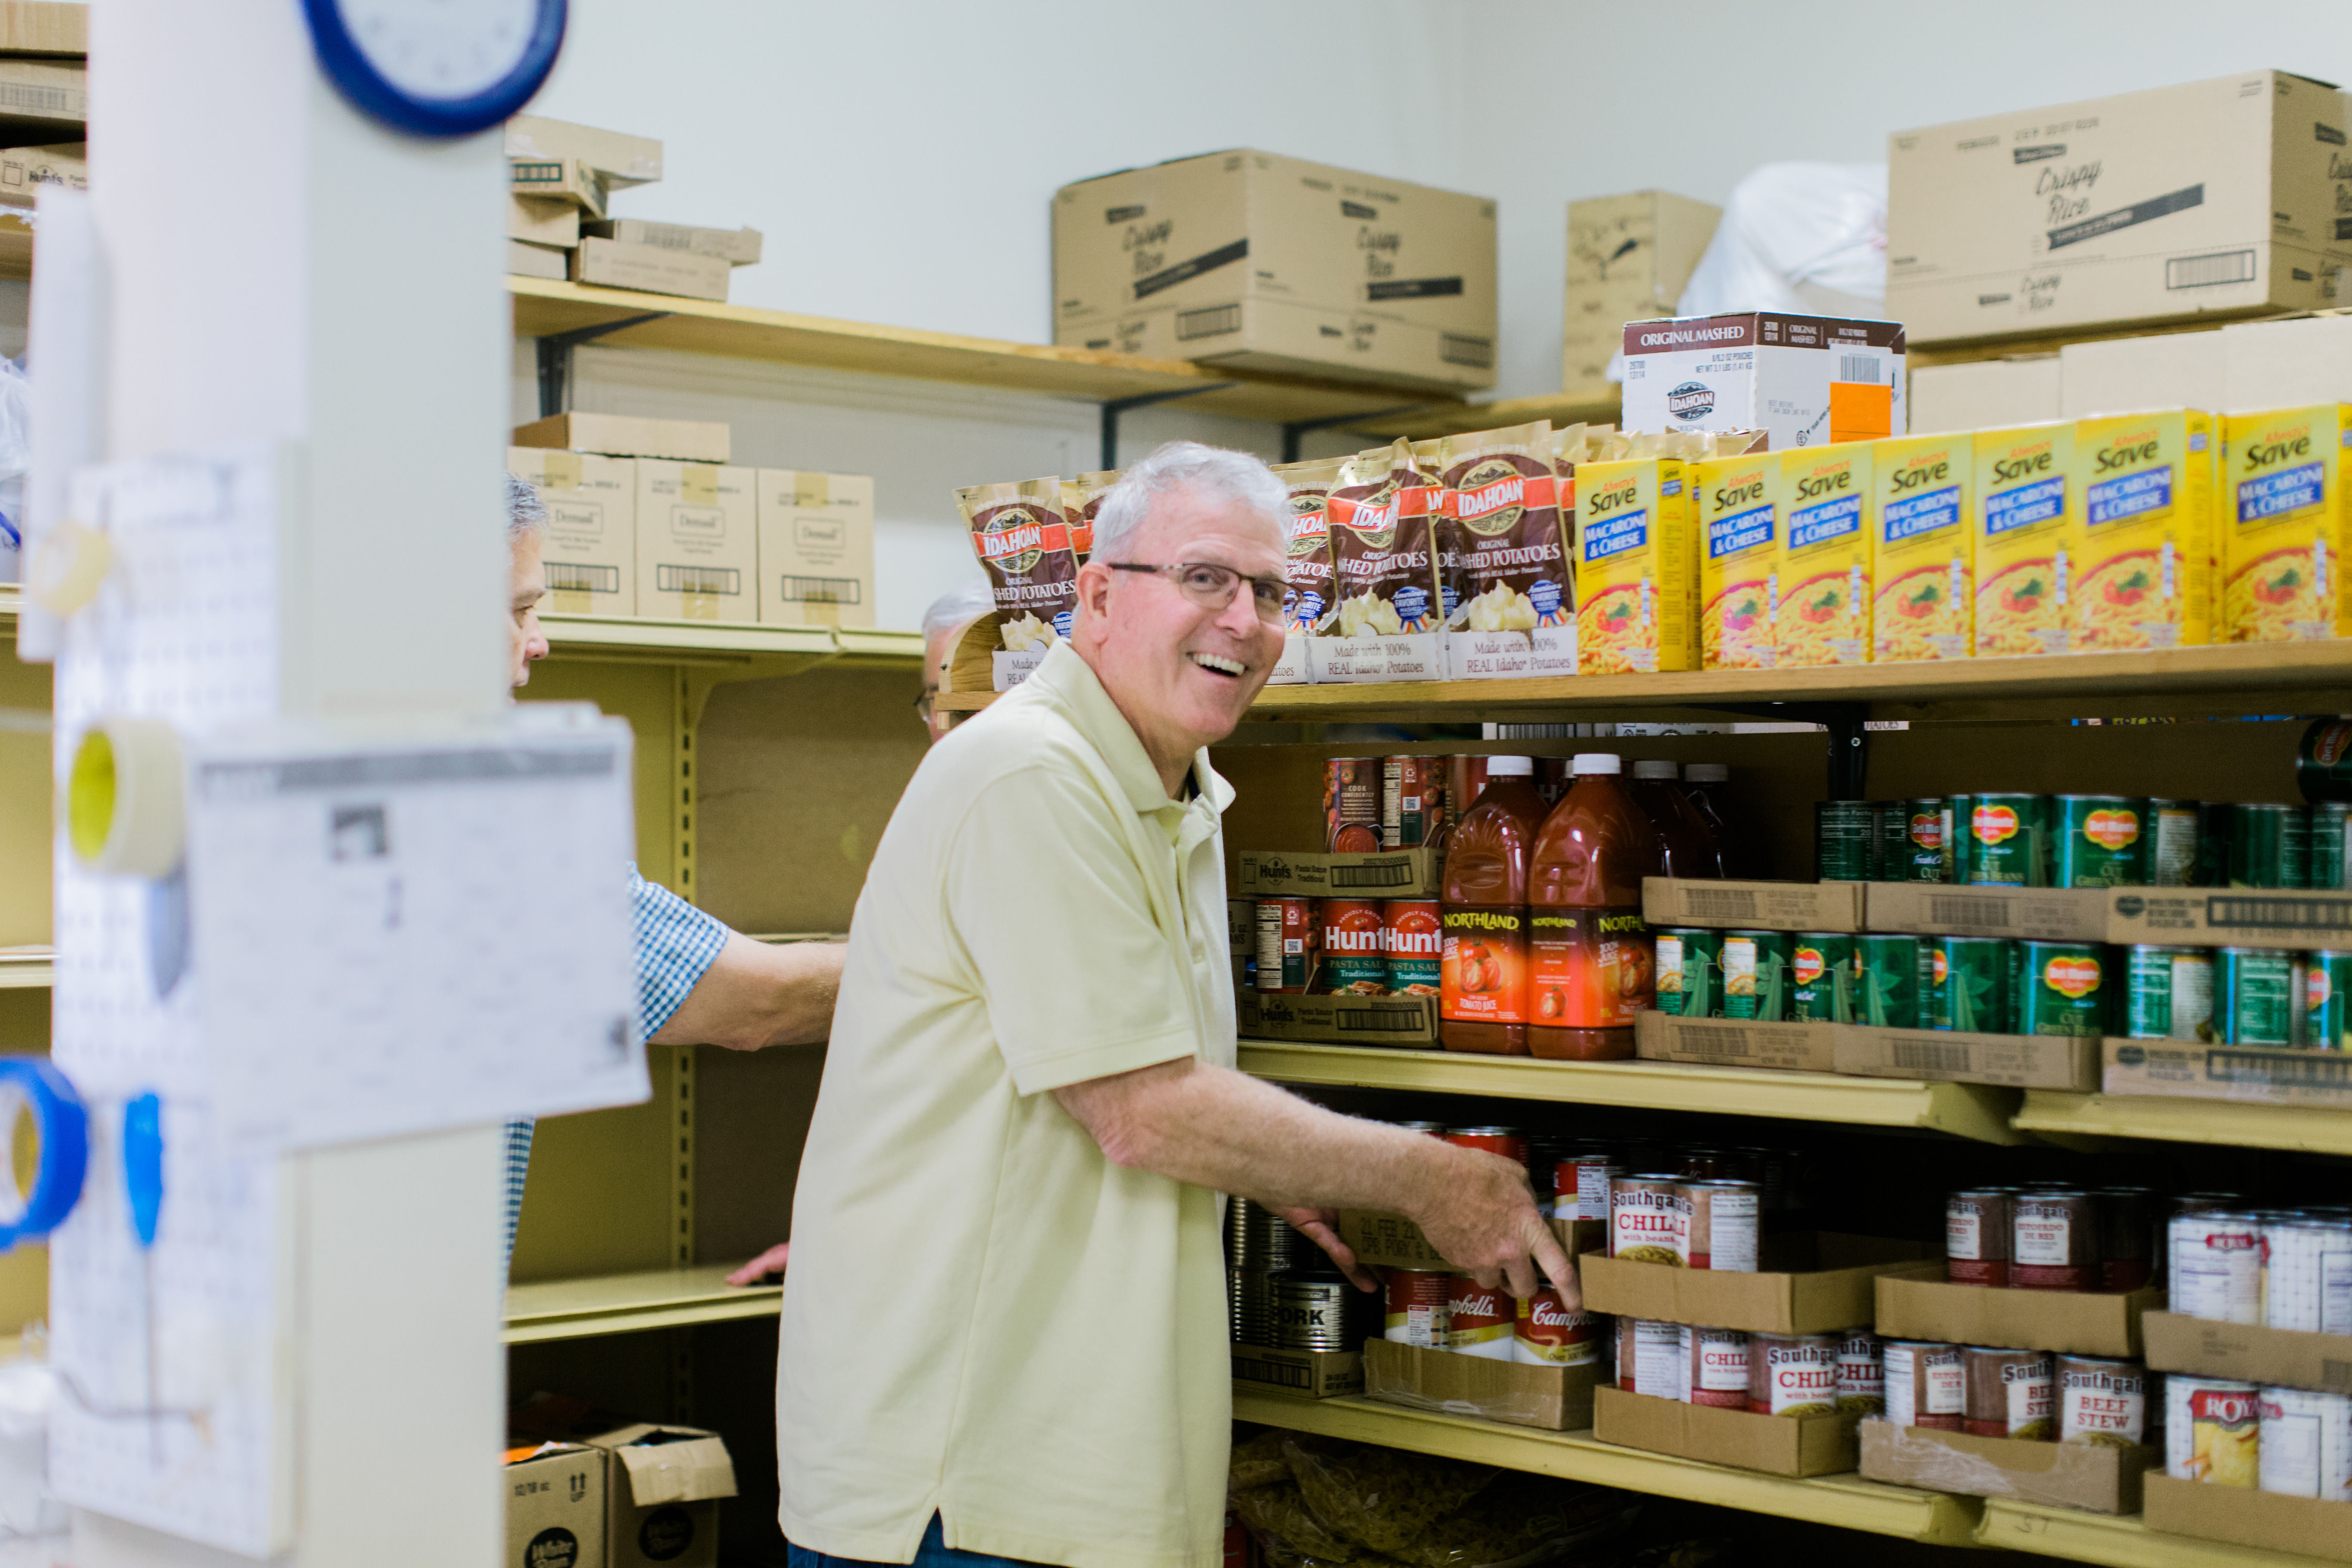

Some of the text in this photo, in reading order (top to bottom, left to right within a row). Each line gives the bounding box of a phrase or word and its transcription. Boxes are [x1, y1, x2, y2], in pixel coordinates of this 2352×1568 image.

[2035, 161, 2103, 195] Crispy
[2047, 194, 2090, 225] Rice
[1640, 326, 1744, 346] ORIGINAL MASHED
[1671, 392, 1713, 411] IDAHOAN
[2113, 429, 2158, 447] Always
[2264, 425, 2310, 444] Always
[2009, 440, 2052, 459] Always
[2094, 440, 2158, 473] Save
[2244, 435, 2310, 472] Save
[1908, 450, 1948, 469] Always
[1992, 452, 2051, 484] Save
[1811, 460, 1850, 478] Always
[1891, 461, 1948, 493] Save
[1602, 476, 1637, 492] Always
[1727, 471, 1763, 489] Always
[1795, 472, 1850, 501] Save
[1458, 479, 1524, 518] IDAHOAN
[1589, 487, 1635, 515] Save
[1713, 482, 1763, 512] Save
[2110, 490, 2162, 515] CHEESE
[2259, 488, 2314, 513] CHEESE
[1902, 509, 1952, 533] CHEESE
[2005, 499, 2055, 526] CHEESE
[1807, 516, 1853, 541] CHEESE
[983, 527, 1041, 557] IDAHOAN
[1477, 539, 1510, 550] ORIGINAL
[1599, 531, 1640, 554] CHEESE
[1725, 526, 1767, 551] CHEESE
[1493, 543, 1561, 567] POTATOES
[1021, 580, 1076, 600] POTATOES
[1395, 597, 1425, 606] FAVORITE
[1335, 643, 1411, 658] Made with 100%
[1475, 639, 1526, 655] Made with
[1012, 658, 1033, 669] Made
[1328, 662, 1352, 675] REAL
[1387, 661, 1424, 674] Potatoes
[1467, 659, 1493, 673] REAL
[1531, 657, 1570, 670] Potatoes
[1912, 824, 1923, 834] Del
[1260, 864, 1292, 879] Hunt's
[1920, 867, 1942, 879] CUT
[1338, 909, 1384, 924] PROUDLY GROWN
[1396, 911, 1440, 926] PROUDLY GROWN
[1443, 912, 1520, 930] NORTHLAND
[1532, 917, 1577, 928] NORTHLAND
[1599, 916, 1647, 933] NORTHL
[1326, 926, 1385, 950] Hunt
[1386, 927, 1441, 953] Hunt
[1329, 960, 1384, 968] PASTA SAU
[1389, 962, 1440, 971] PASTA SAU
[1397, 972, 1441, 980] Traditional
[1459, 998, 1498, 1011] TOMATO JUICE
[1613, 1189, 1676, 1211] Southga
[1378, 1219, 1397, 1237] FEB
[1619, 1214, 1672, 1231] CHIL
[1623, 1233, 1643, 1242] with
[1700, 1332, 1748, 1345] Southga
[1705, 1353, 1748, 1365] CHIL
[1770, 1347, 1835, 1365] Southga
[1923, 1353, 1962, 1366] South
[1780, 1370, 1835, 1388] CHIL
[1837, 1363, 1884, 1380] CHIL
[2003, 1360, 2055, 1383] South
[1786, 1391, 1809, 1400] with
[2081, 1396, 2130, 1411] BEEF
[2206, 1395, 2258, 1422] ROYA
[2077, 1414, 2129, 1429] STEW
